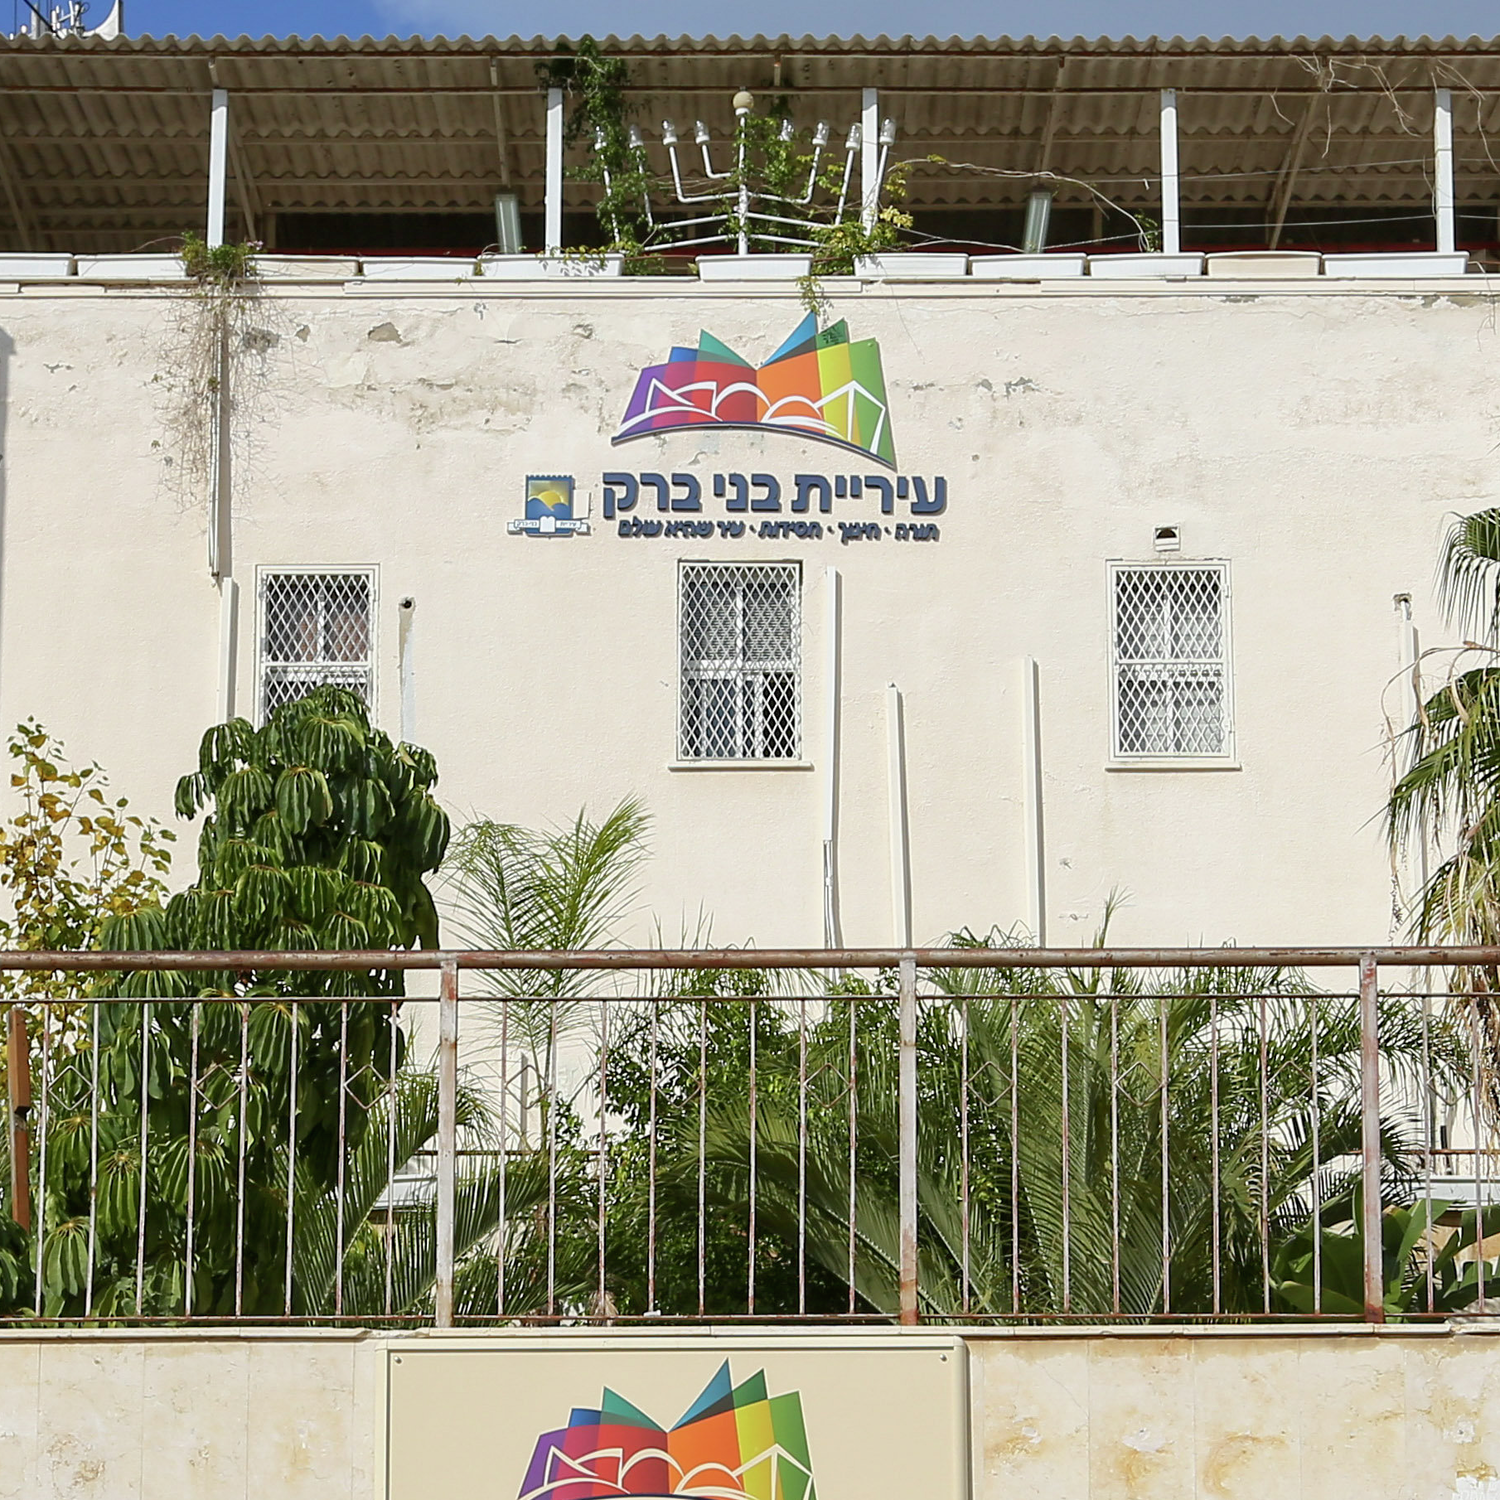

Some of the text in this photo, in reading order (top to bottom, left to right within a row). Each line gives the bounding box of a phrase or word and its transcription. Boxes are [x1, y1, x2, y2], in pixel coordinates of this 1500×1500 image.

[602, 472, 946, 519] עיריית בני ברק
[664, 519, 715, 538] שהיא
[717, 520, 746, 538] עיר
[758, 521, 822, 540] חסידות
[838, 522, 881, 545] חינוך
[894, 523, 939, 541] תורה
